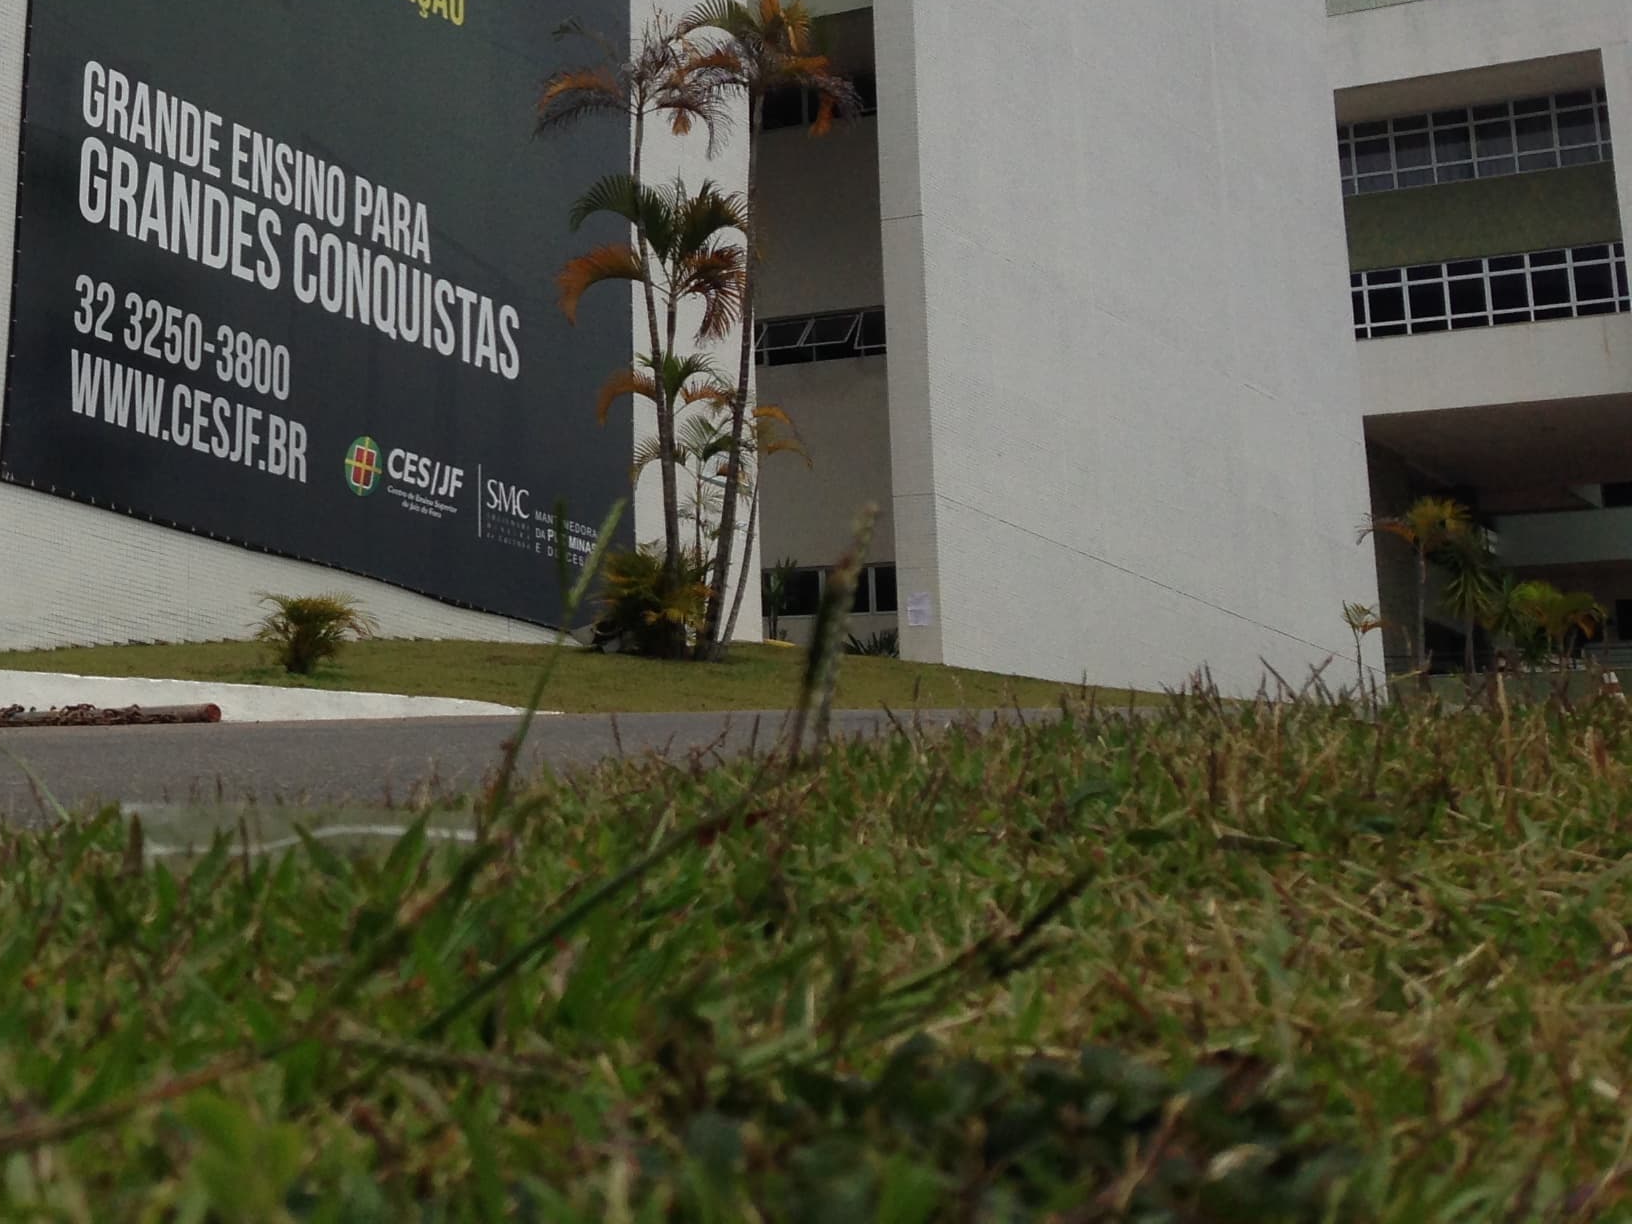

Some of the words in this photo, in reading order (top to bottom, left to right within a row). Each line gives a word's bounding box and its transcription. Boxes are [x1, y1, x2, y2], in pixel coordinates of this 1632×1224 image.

[83, 60, 222, 178] GRANDE
[232, 122, 345, 228] ENSINO
[355, 175, 430, 264] PARA
[79, 136, 281, 291] GRANDES
[293, 223, 520, 380] CONQUISTAS
[74, 274, 115, 342] 32
[124, 291, 290, 401] 3250-3800
[71, 348, 307, 484] WWW.CESJF.BR
[486, 479, 530, 519] SMC
